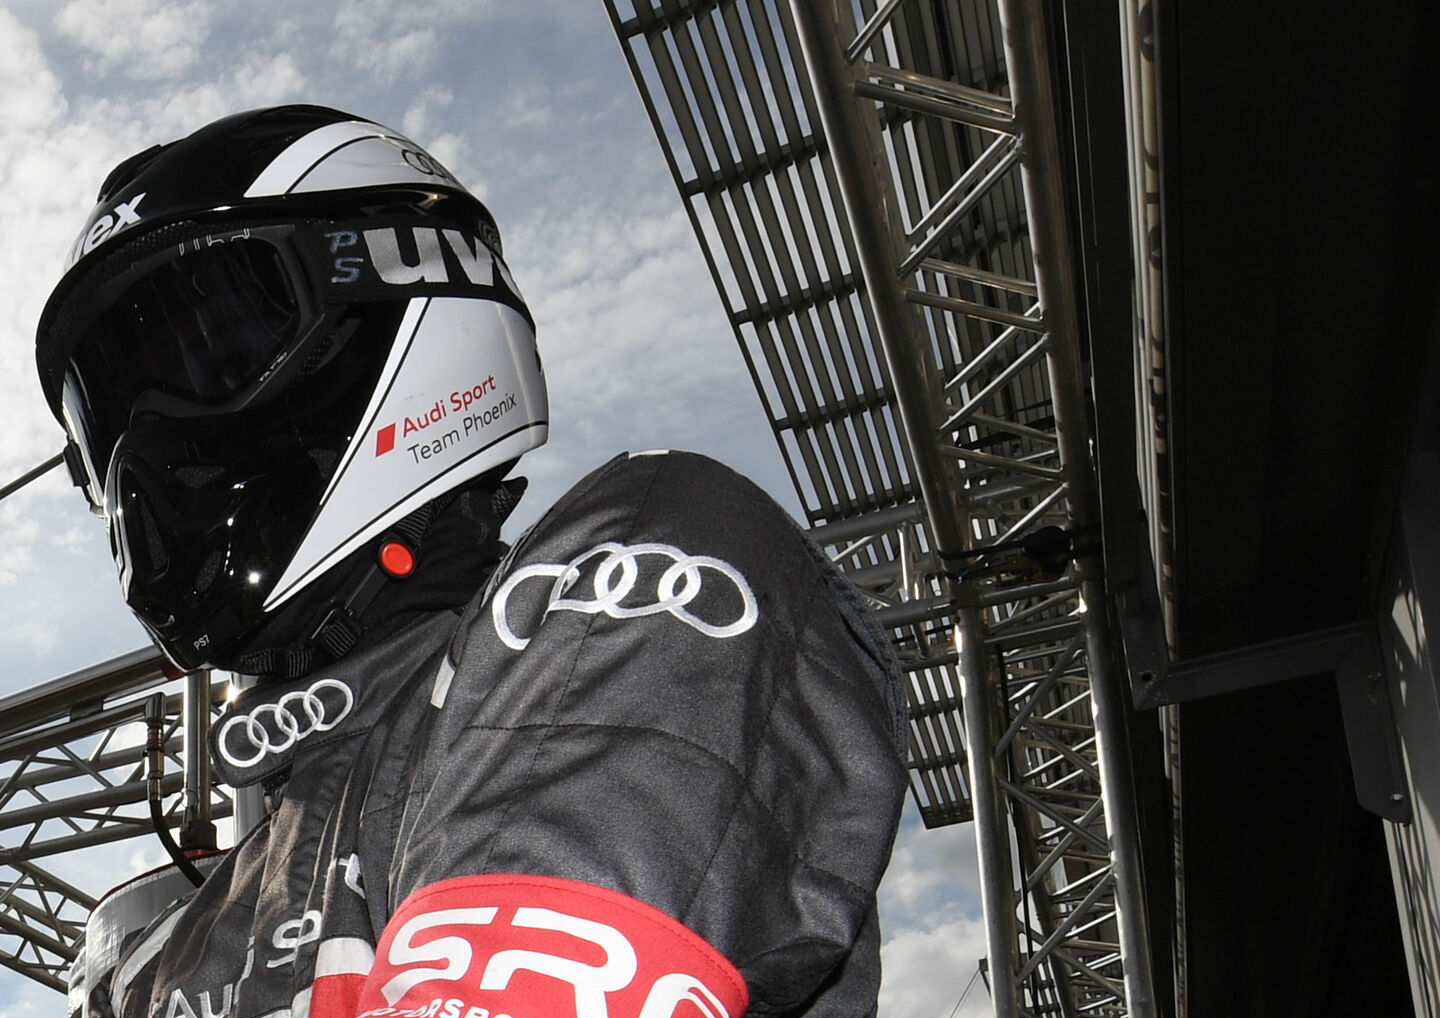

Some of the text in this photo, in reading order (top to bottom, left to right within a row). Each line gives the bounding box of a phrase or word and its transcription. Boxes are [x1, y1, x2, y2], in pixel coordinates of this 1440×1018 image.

[403, 374, 497, 438] Audi Sport
[407, 393, 517, 464] Team Phoenix
[193, 633, 210, 650] PS7
